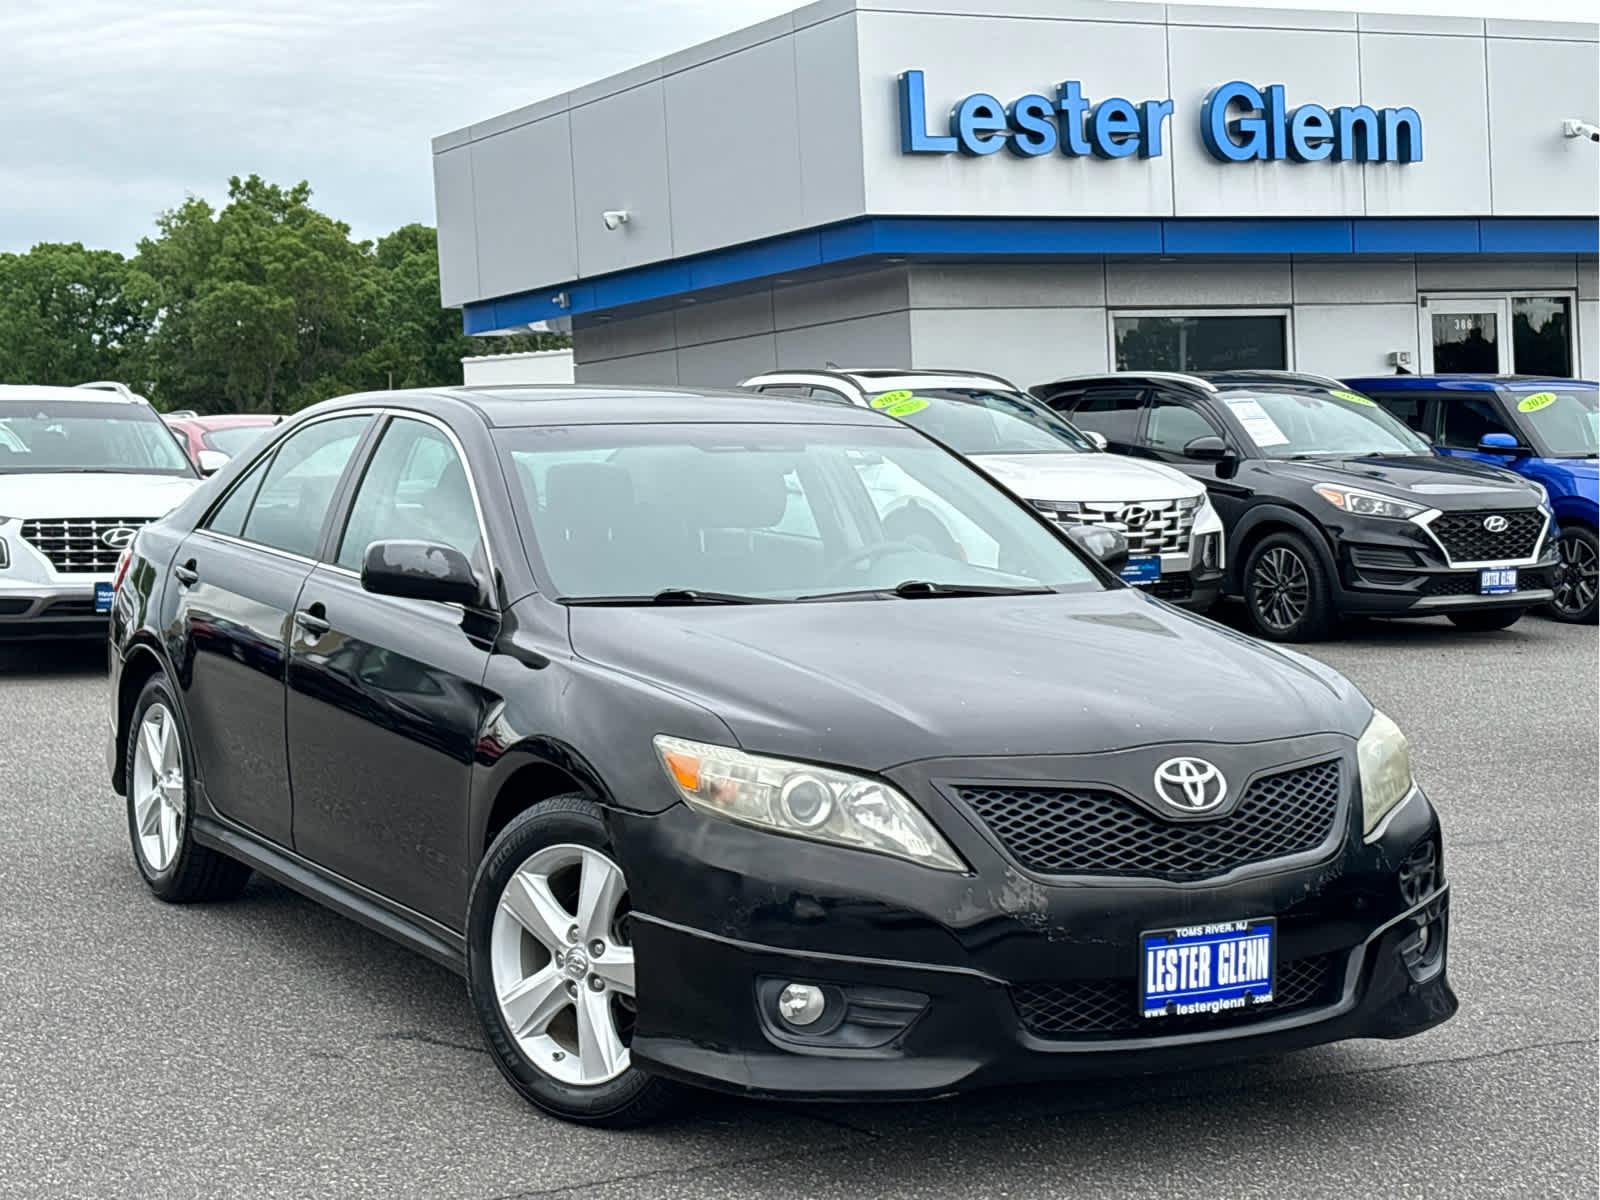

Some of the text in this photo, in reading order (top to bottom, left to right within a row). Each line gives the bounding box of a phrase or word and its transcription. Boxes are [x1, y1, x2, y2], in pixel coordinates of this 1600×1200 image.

[898, 70, 1423, 162] Lester Glenn
[1526, 394, 1549, 410] 2021
[1175, 926, 1203, 938] TOMS
[1236, 920, 1248, 931] NJ
[1147, 938, 1268, 993] LESTER GLENN
